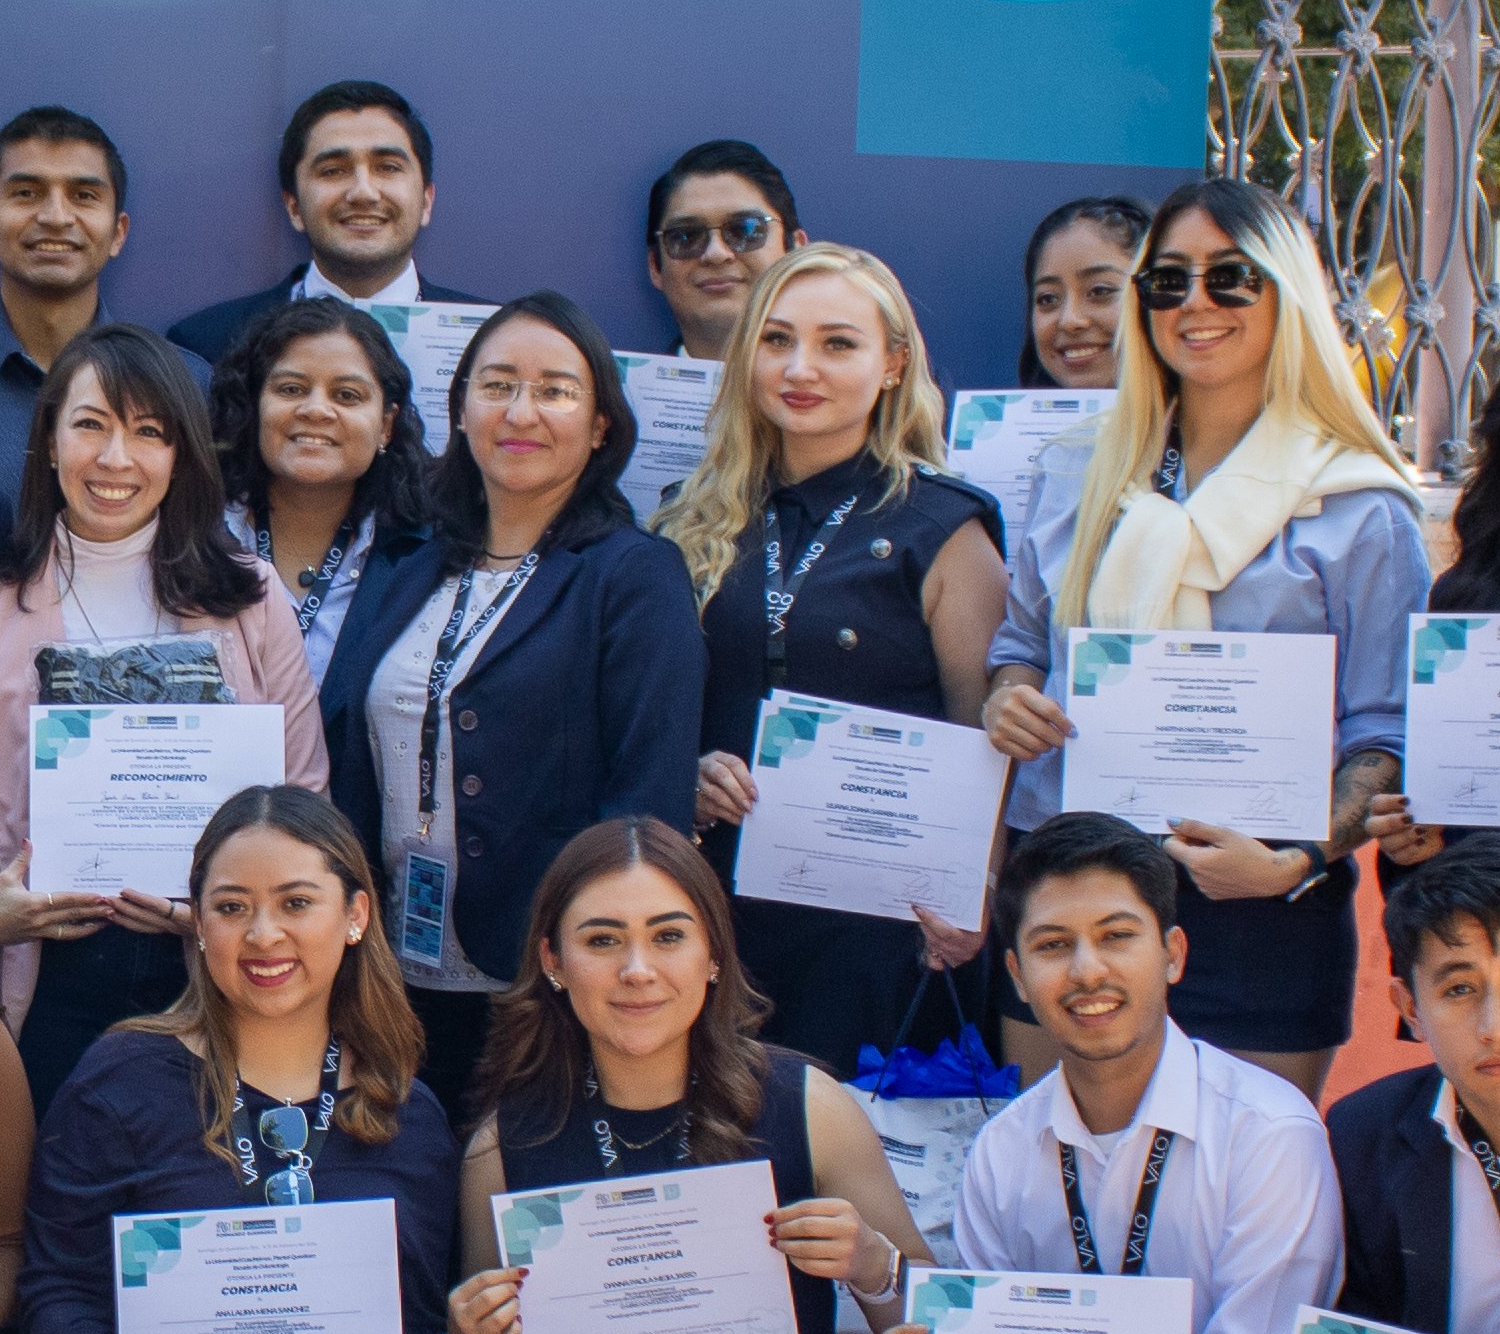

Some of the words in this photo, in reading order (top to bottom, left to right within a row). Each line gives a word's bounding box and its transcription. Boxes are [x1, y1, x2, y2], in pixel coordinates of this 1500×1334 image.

[1160, 448, 1179, 489] VALO
[318, 547, 343, 581] VALO
[507, 553, 540, 588] VALO
[794, 542, 826, 575] VALO
[299, 596, 321, 631] VALO
[442, 610, 463, 640] VALO
[465, 606, 496, 640] VALO
[1164, 704, 1237, 715] CONSTANCIA
[110, 773, 207, 782] RECONOCIMIENTO
[422, 760, 432, 797] VALO
[840, 782, 908, 800] CONSTANCIA
[314, 1092, 335, 1131] VALO
[595, 1120, 617, 1167] VALO
[1143, 1136, 1169, 1185] VALO
[1073, 1216, 1095, 1268] VALO
[1126, 1213, 1148, 1262] VALO
[606, 1249, 684, 1267] CONSTANCIA
[221, 1283, 298, 1296] CONSTANCIA
